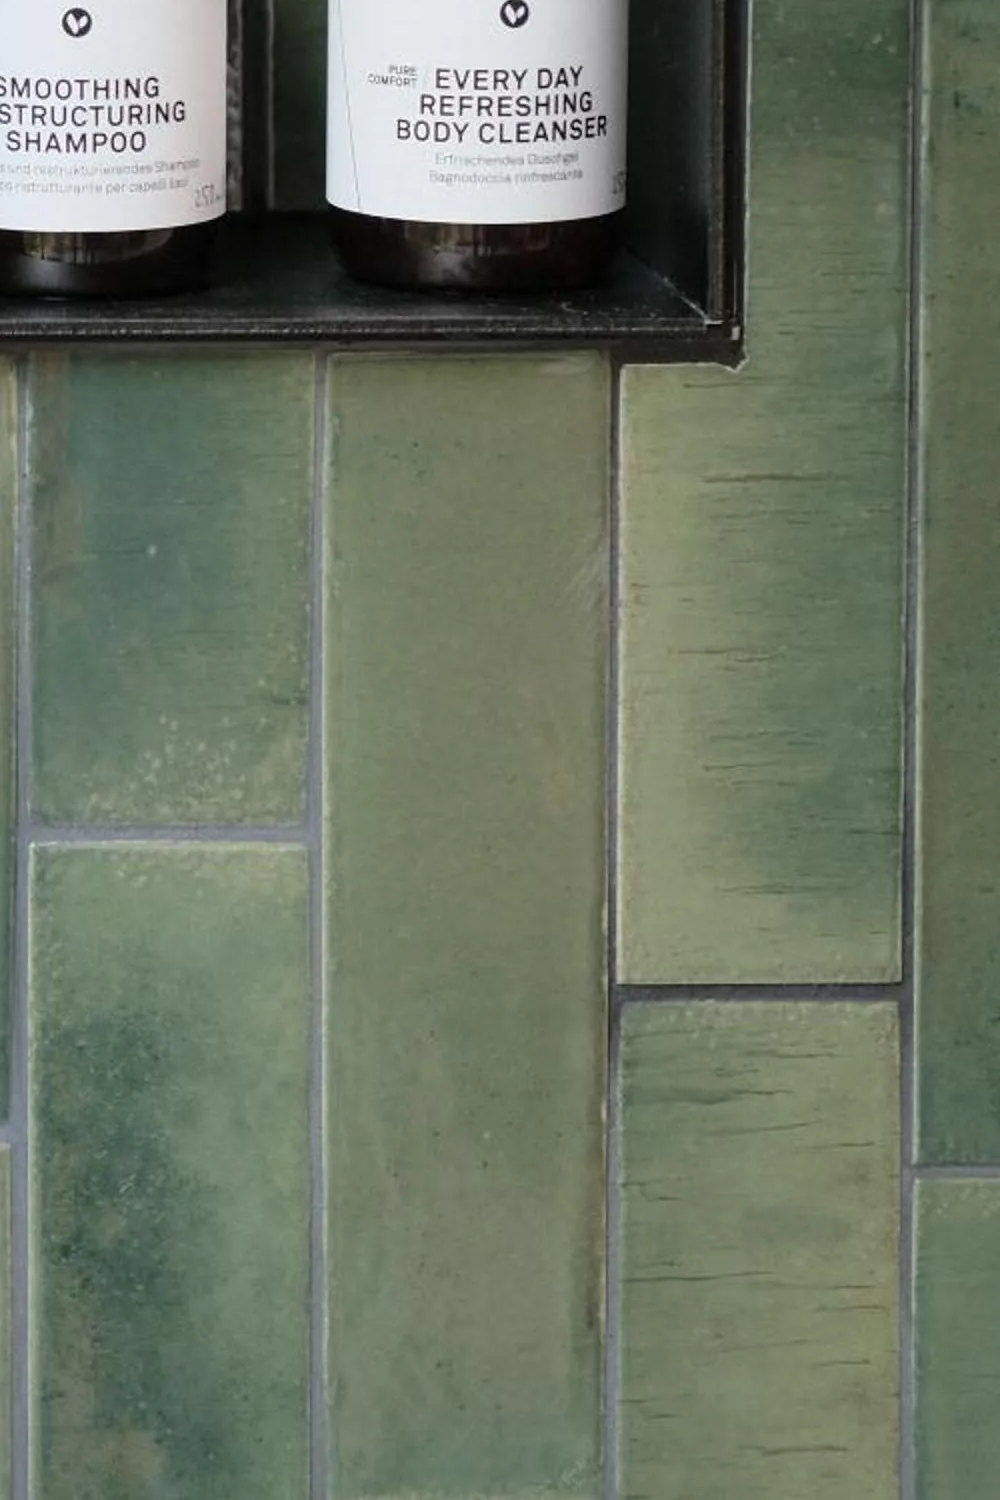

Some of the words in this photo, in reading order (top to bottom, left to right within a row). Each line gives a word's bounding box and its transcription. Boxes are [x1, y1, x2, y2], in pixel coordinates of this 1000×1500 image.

[367, 75, 417, 88] COMFORT
[388, 65, 416, 76] PURE
[435, 68, 529, 91] EVERY
[536, 66, 583, 90] DAY
[420, 91, 593, 117] REFRESHING
[6, 130, 147, 154] SHAMPOO
[396, 119, 469, 143] BODY
[478, 115, 608, 145] CLEANSER
